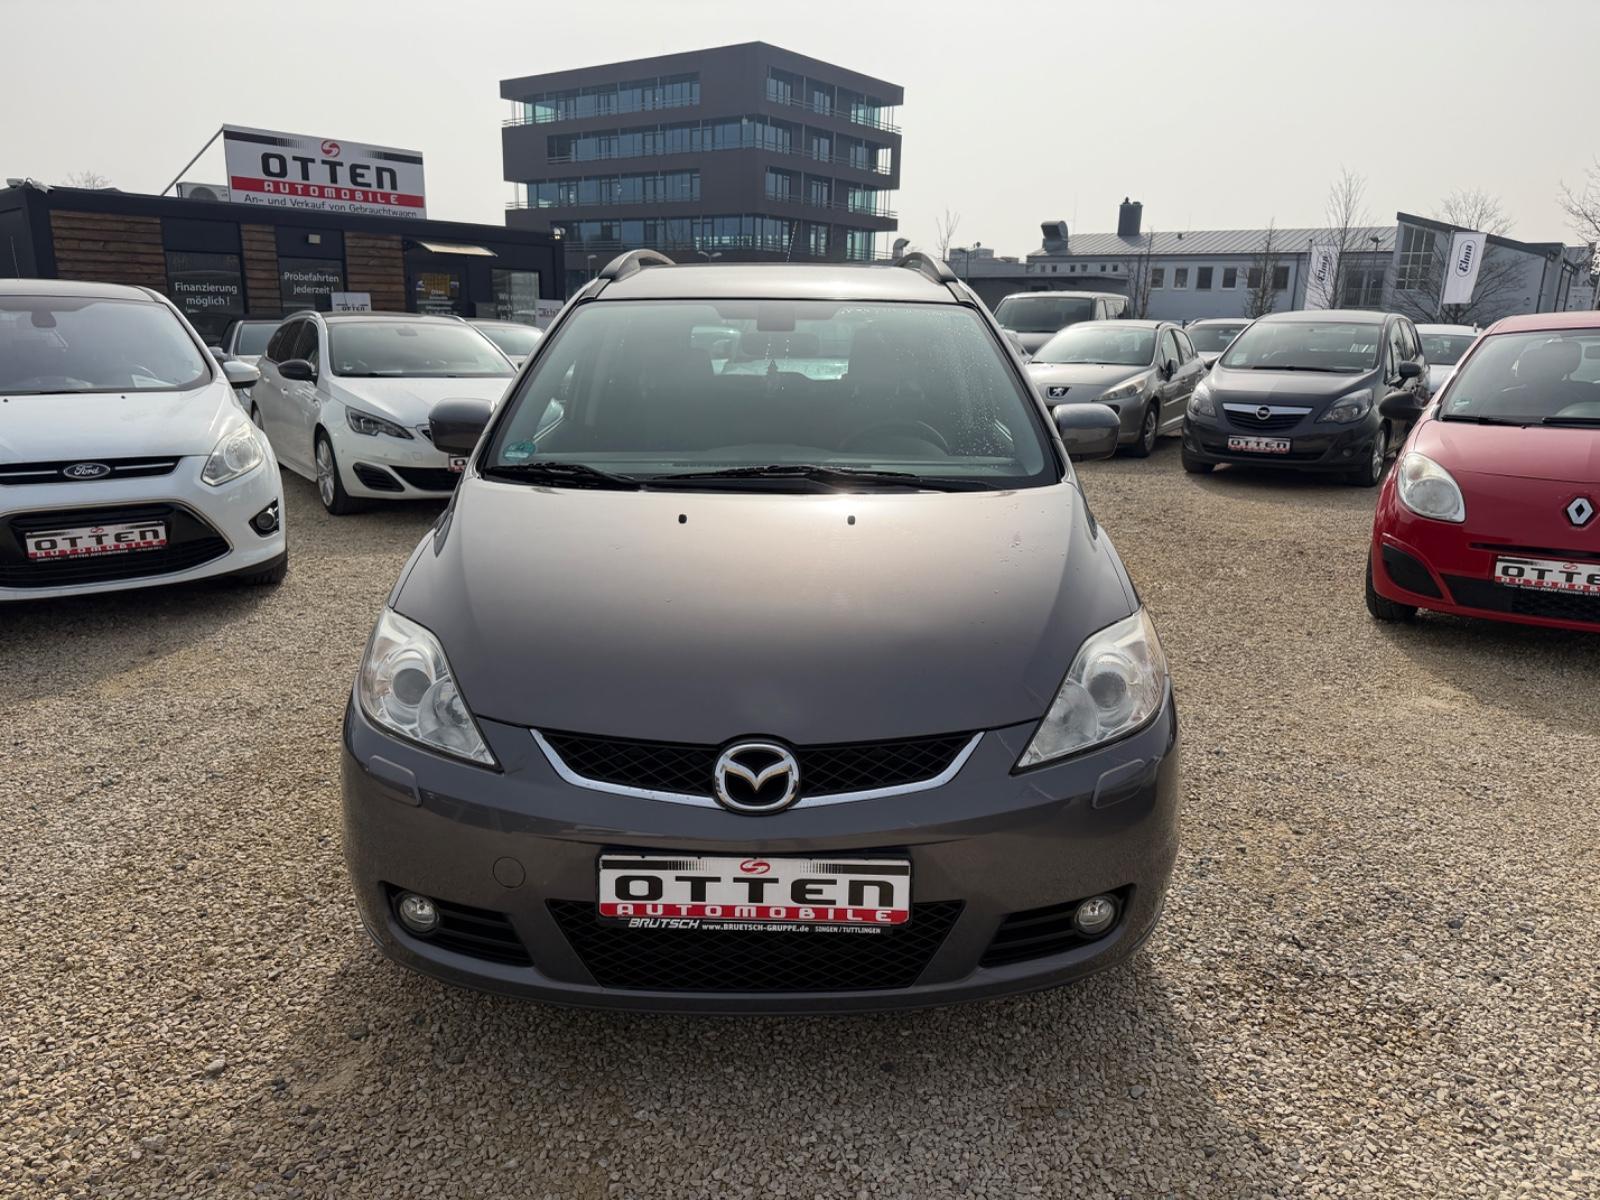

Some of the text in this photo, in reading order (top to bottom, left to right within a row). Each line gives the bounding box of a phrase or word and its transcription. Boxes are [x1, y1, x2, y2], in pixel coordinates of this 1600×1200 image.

[260, 152, 398, 191] OTTEN
[263, 181, 398, 204] AUTOMOBILE
[244, 193, 417, 217] An- und Verkauf von Gebrauchtwagen
[1458, 244, 1473, 273] Elma
[284, 271, 340, 283] Probefahrten
[175, 282, 238, 294] Finanzierung
[1231, 440, 1287, 448] OTTEN
[73, 463, 100, 476] Ford
[34, 529, 160, 551] OTTEN
[615, 875, 894, 907] OTTEN
[617, 904, 892, 922] AUTOMOBILE
[702, 922, 809, 933] www.BRUETSCH-GRUPPE.de
